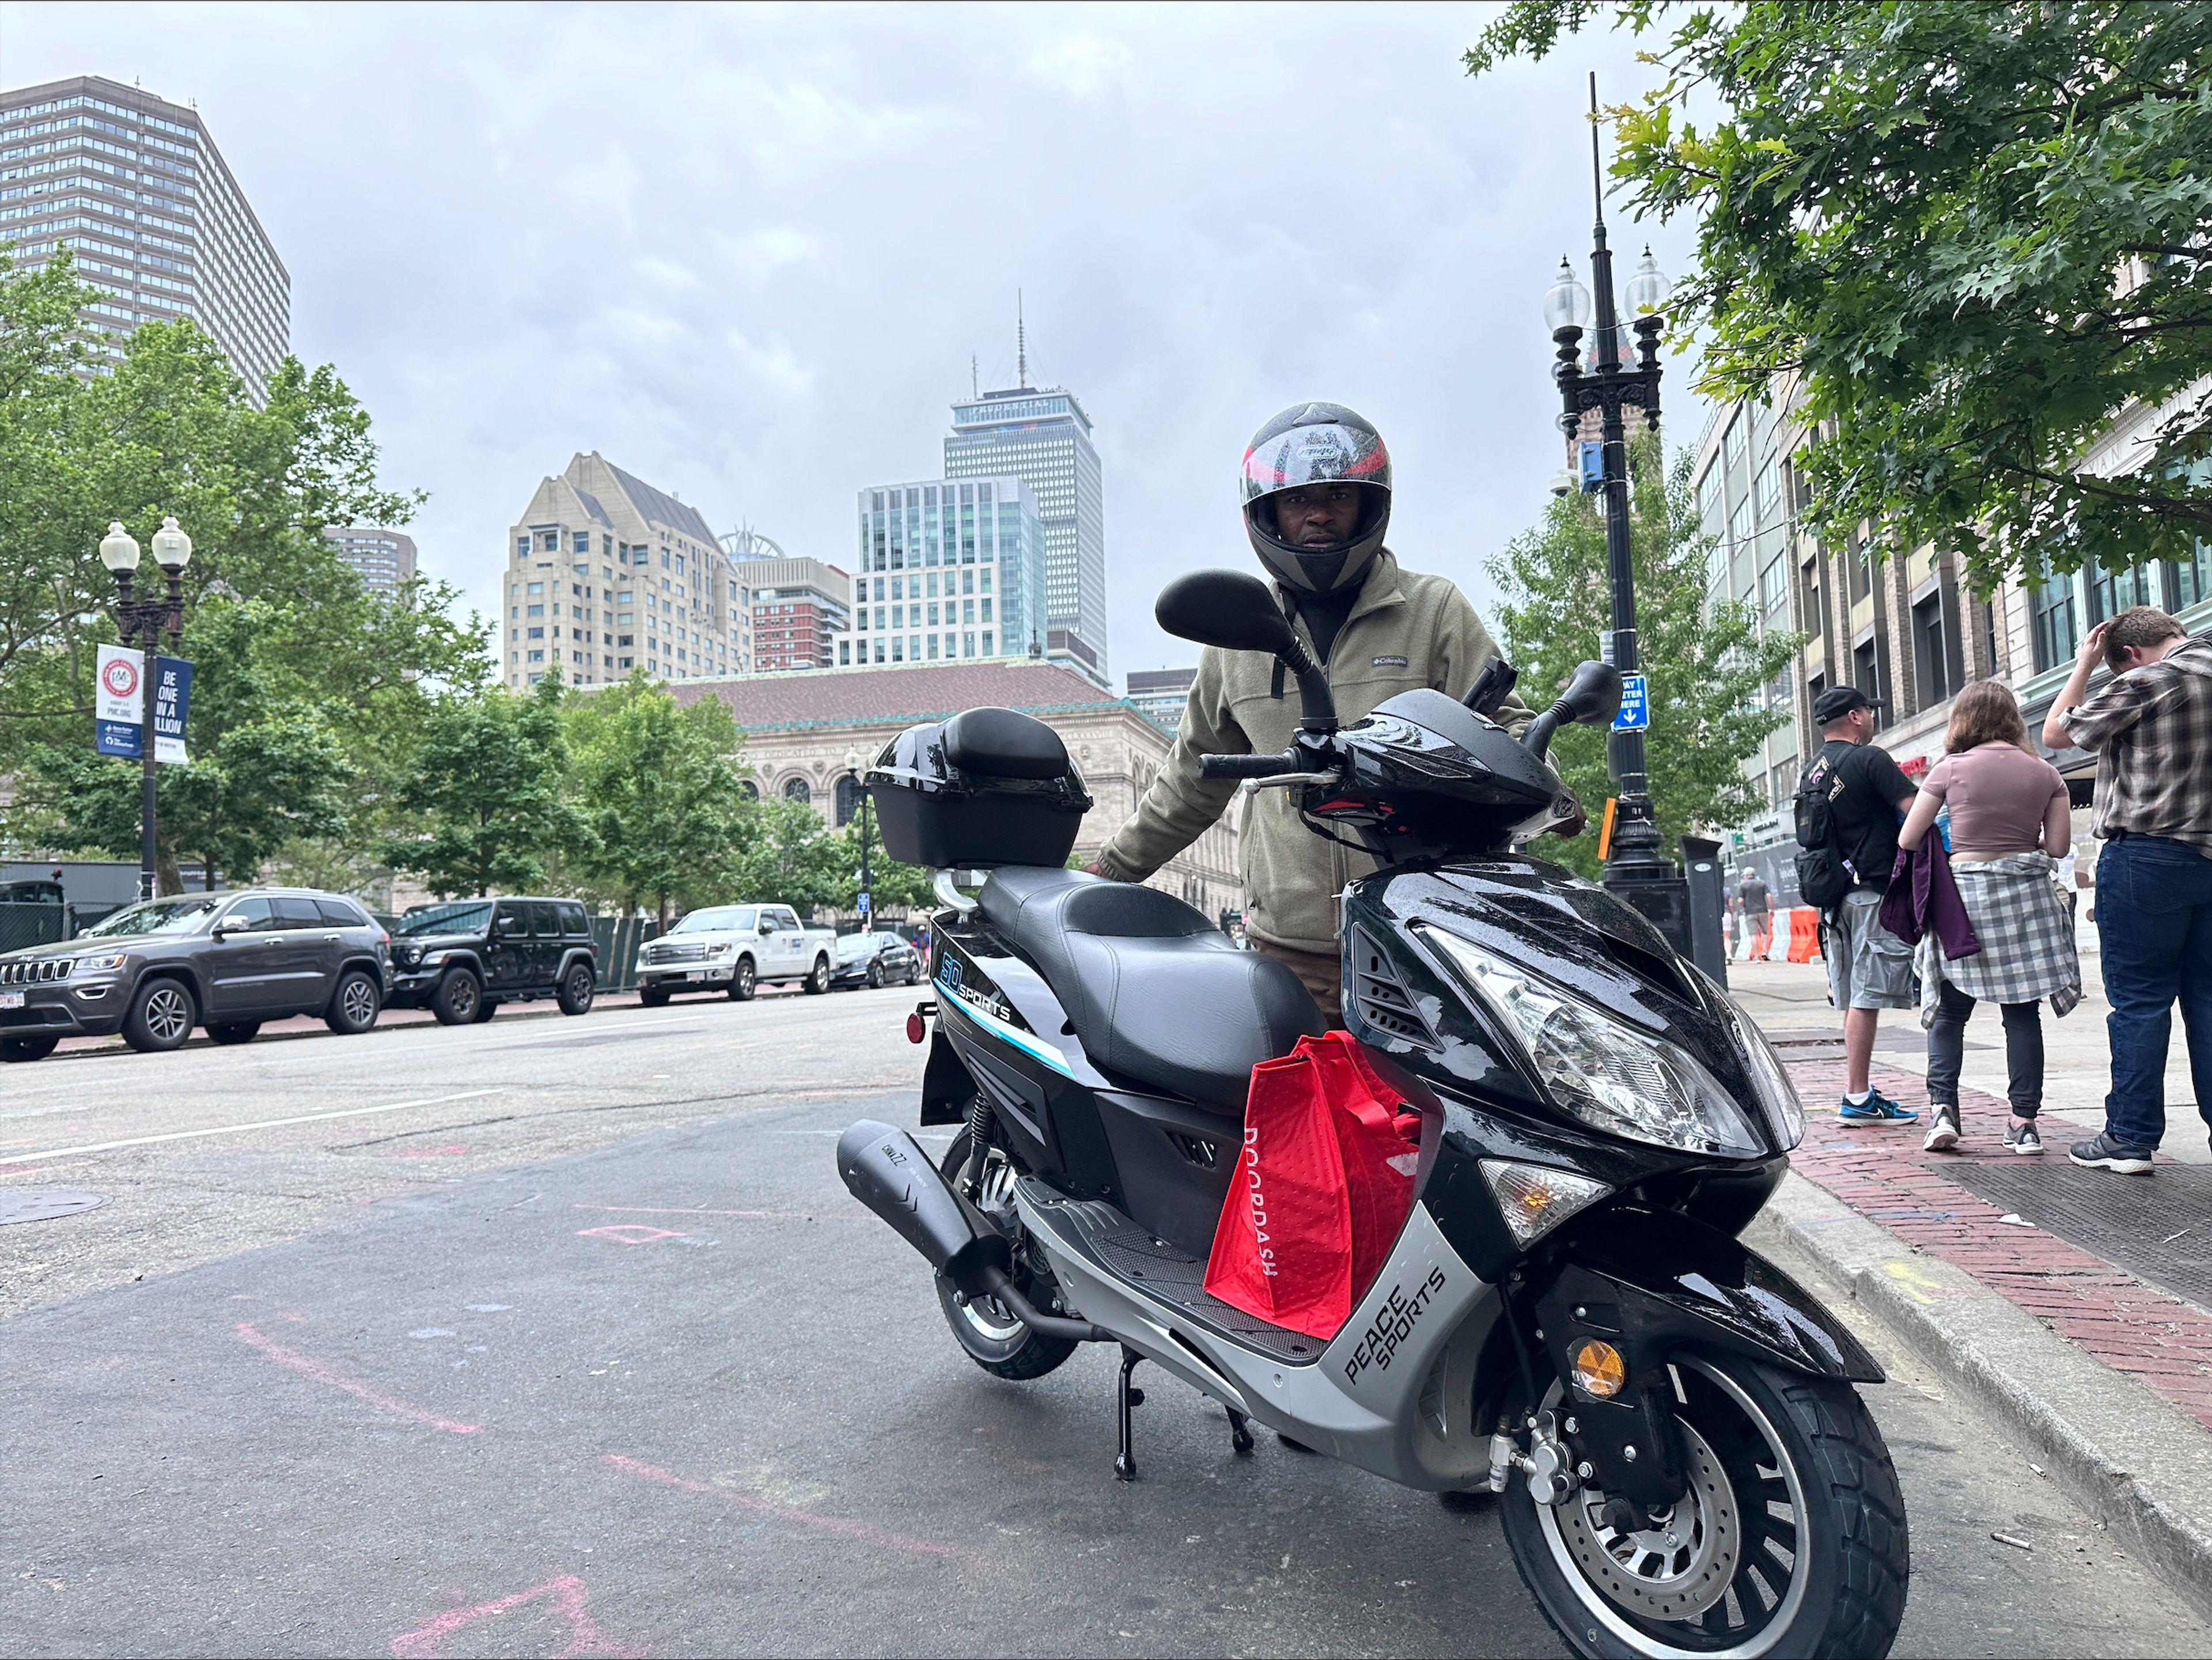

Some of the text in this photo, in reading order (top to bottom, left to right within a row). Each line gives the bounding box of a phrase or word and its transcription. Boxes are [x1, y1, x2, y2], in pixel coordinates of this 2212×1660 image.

[972, 399, 1050, 414] PRUDENTIAL
[163, 670, 176, 686] BE
[1622, 680, 1635, 689] AY
[158, 685, 179, 702] ONE
[1622, 690, 1643, 699] ETER
[156, 702, 176, 718] IN A
[154, 717, 182, 734] ILLION
[940, 951, 1011, 1021] 50 SPORTS
[1244, 1127, 1278, 1277] DOORDASH
[1375, 1265, 1446, 1371] SPORTS
[1344, 1284, 1408, 1386] PEACE
